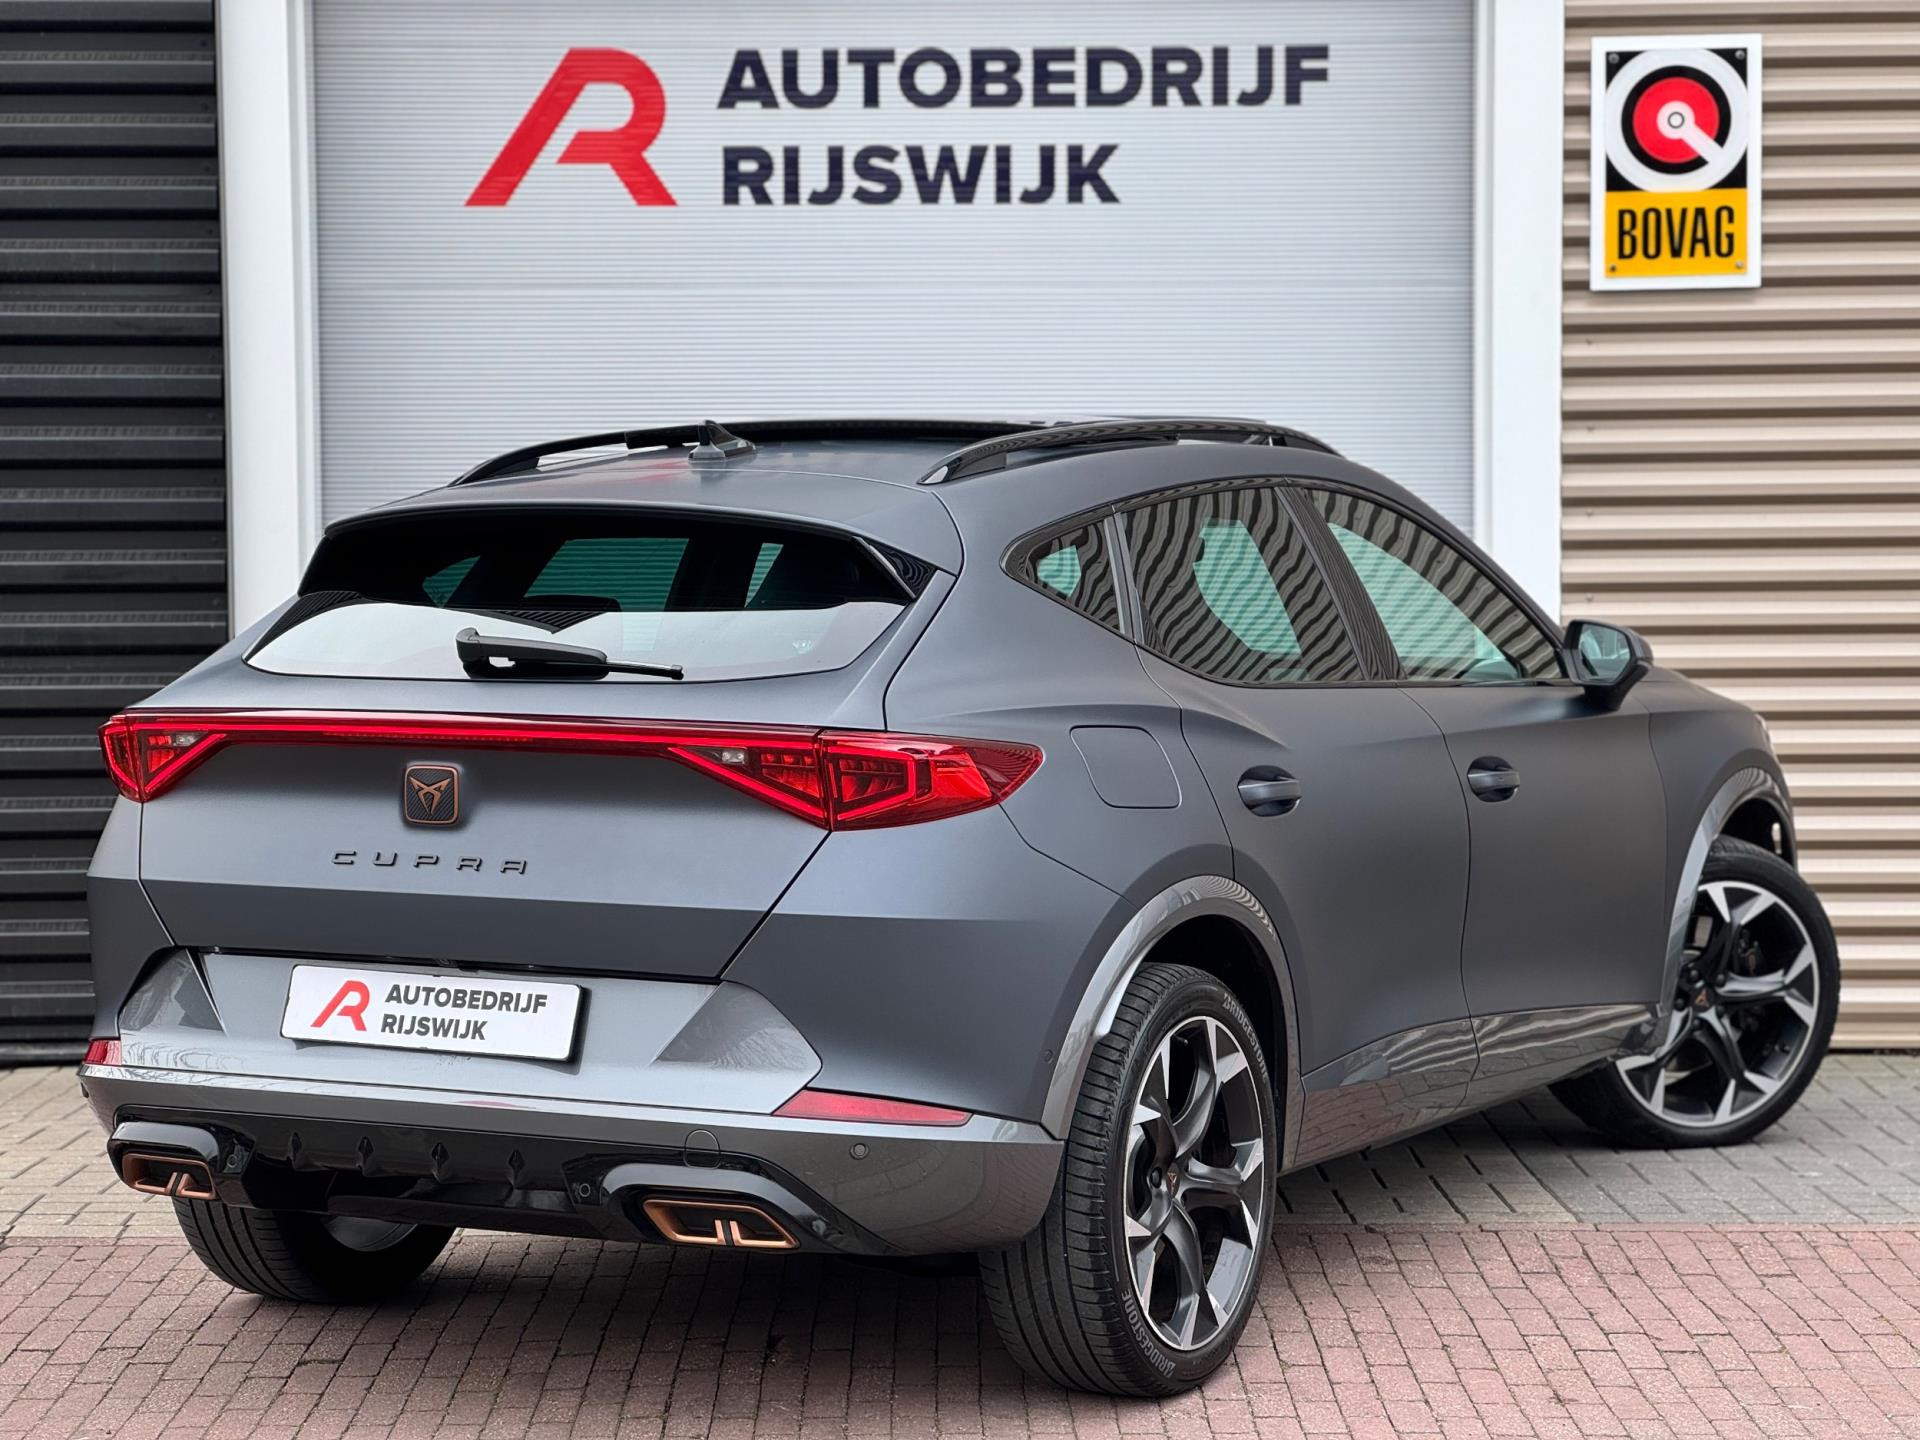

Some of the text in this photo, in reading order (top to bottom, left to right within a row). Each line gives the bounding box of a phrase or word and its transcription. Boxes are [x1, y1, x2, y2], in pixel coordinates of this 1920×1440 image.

[717, 45, 1329, 109] AUTOBEDRIJF
[722, 144, 1121, 205] RIJSWIJK
[1617, 205, 1735, 260] BOVAG
[332, 850, 528, 875] CUPRA
[380, 1013, 489, 1041] RIJSWIJK
[384, 983, 548, 1014] AUTOBEDRIJF
[1222, 991, 1269, 1084] BRIDGESTONE
[1121, 1287, 1177, 1379] BRIDGESTONE
